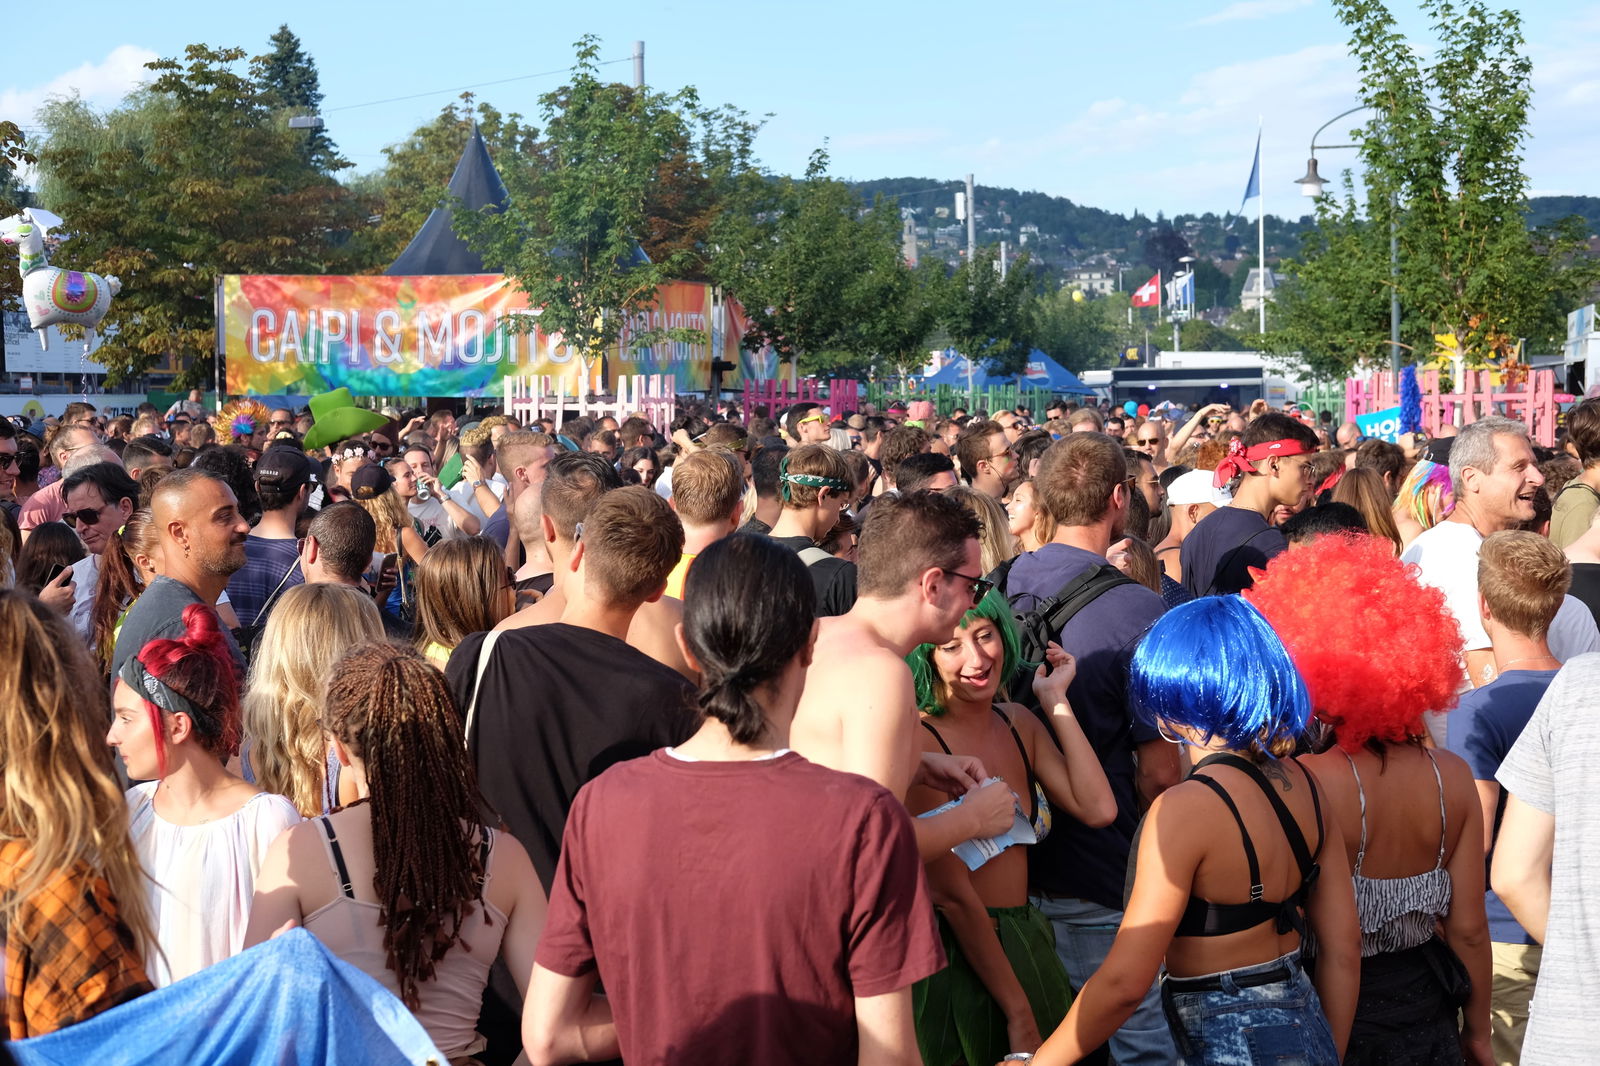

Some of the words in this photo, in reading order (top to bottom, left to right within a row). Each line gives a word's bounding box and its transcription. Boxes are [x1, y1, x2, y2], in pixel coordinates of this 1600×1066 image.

[250, 307, 360, 365] CAIPI
[373, 307, 405, 365] &
[663, 311, 706, 361] MOJITO
